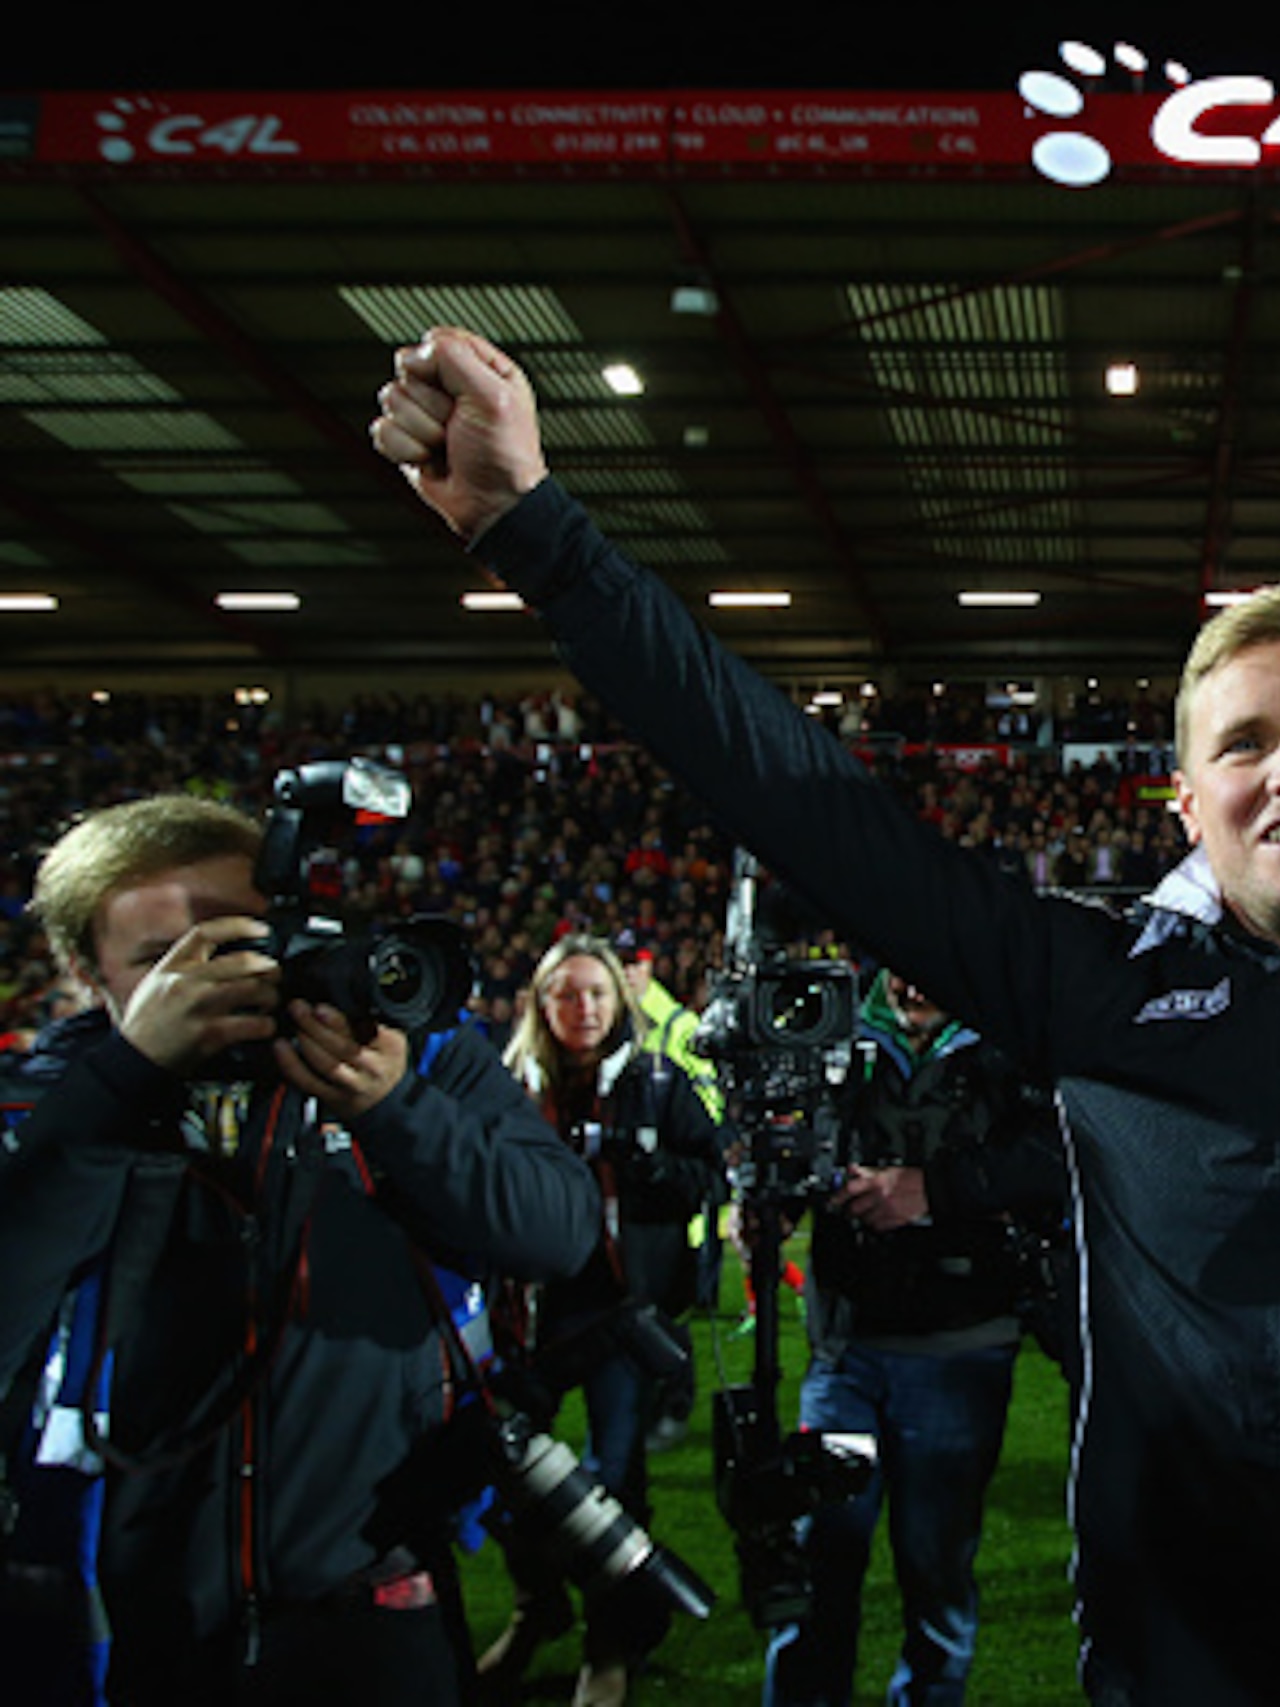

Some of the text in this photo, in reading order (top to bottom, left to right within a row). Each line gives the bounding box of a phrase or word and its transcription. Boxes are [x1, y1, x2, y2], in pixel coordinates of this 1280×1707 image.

[350, 103, 980, 127] COLOCATION CONNECTIVITY CLOUD COMMUNICATIONS
[147, 114, 302, 155] C4L
